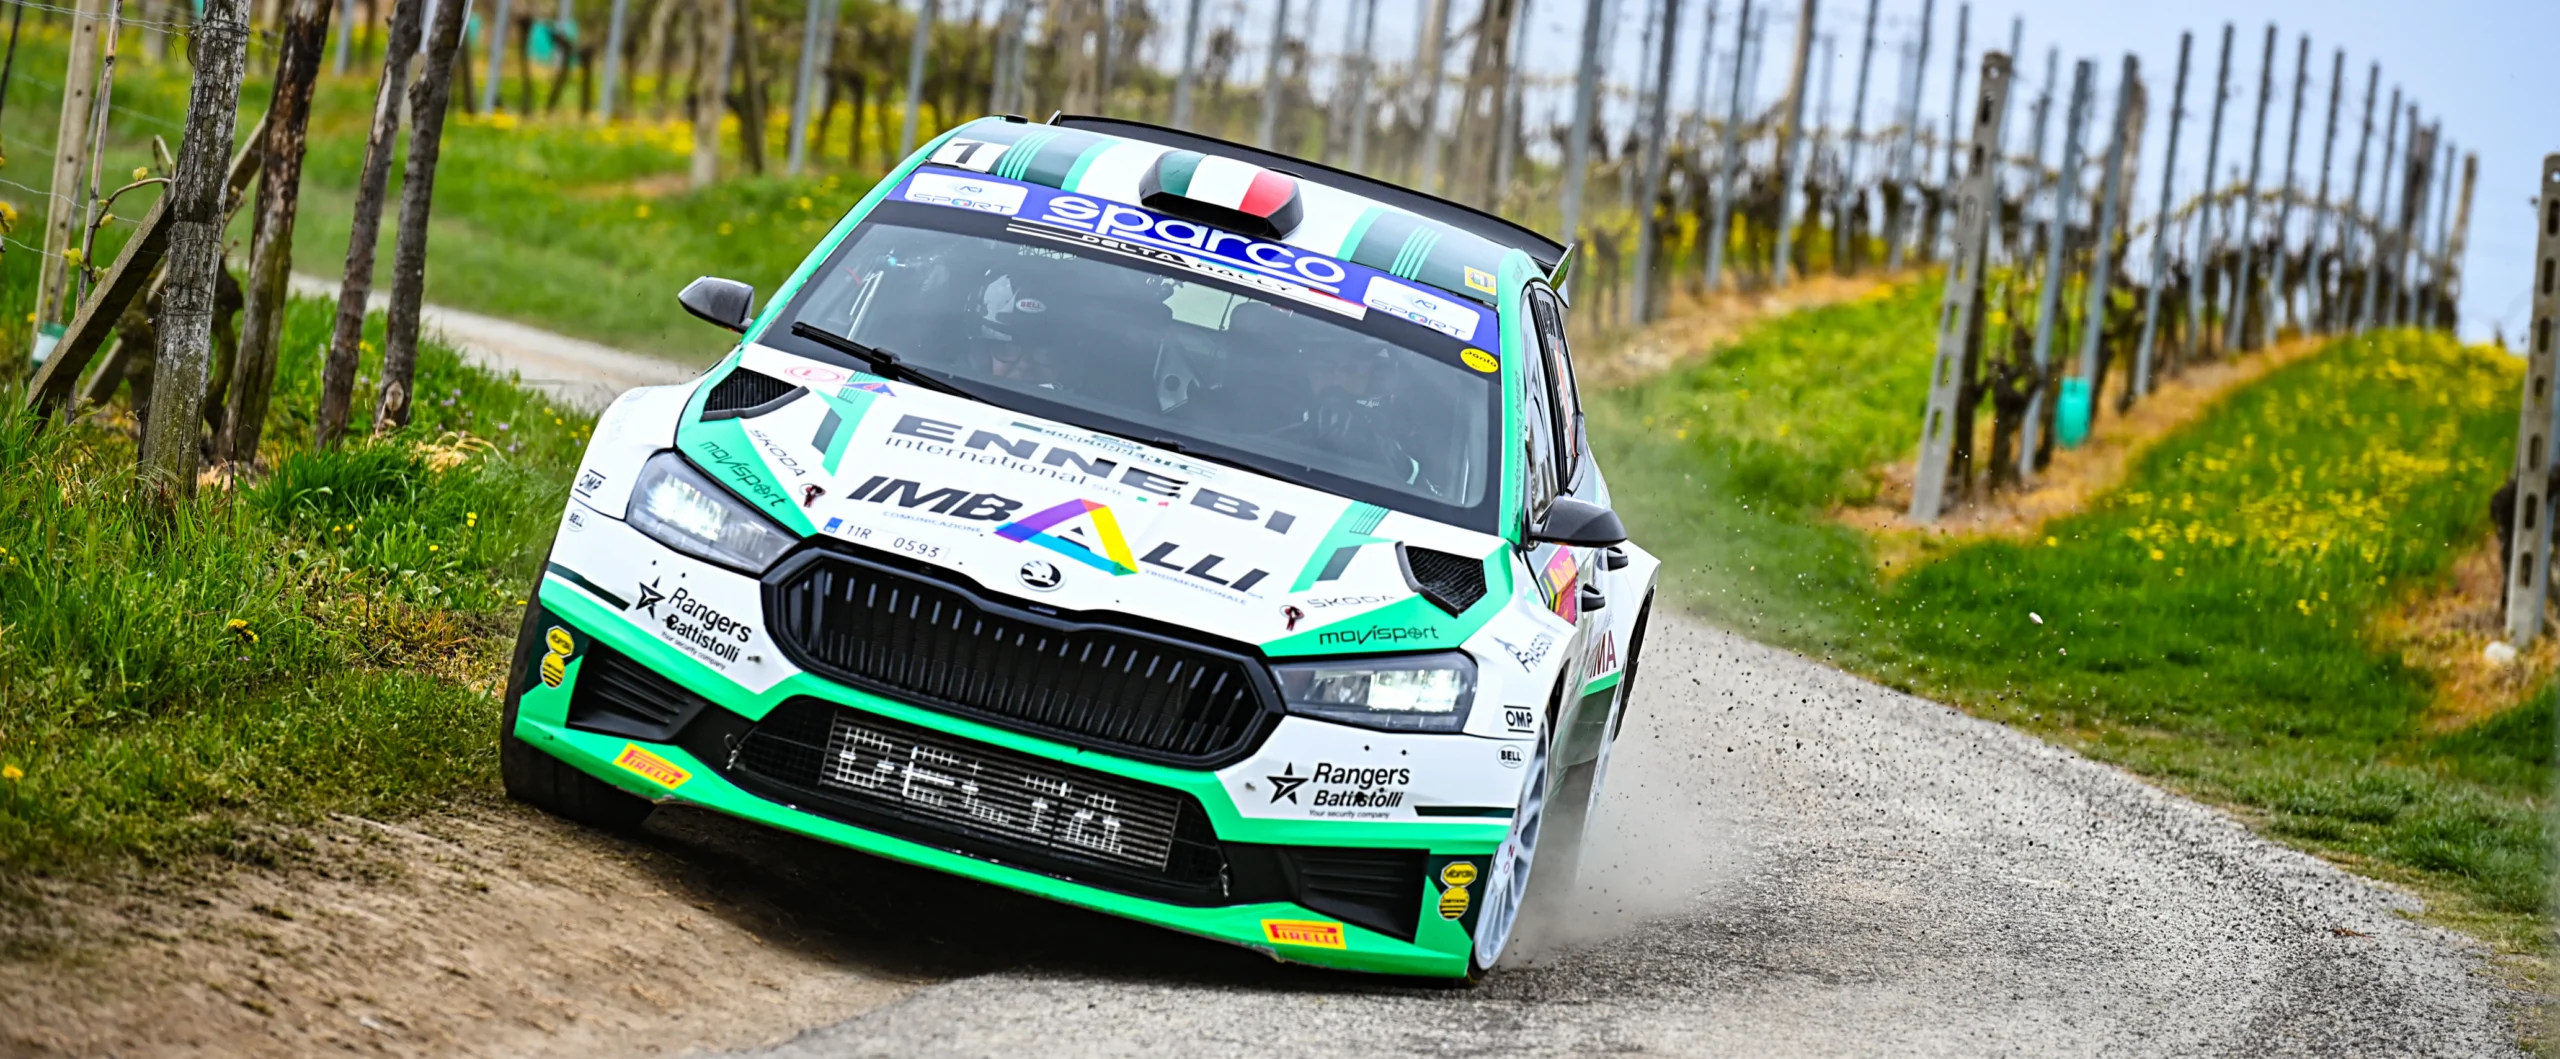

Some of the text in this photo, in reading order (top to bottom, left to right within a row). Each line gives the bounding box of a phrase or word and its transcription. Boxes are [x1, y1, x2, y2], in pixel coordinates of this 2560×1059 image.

[953, 142, 985, 165] 1
[913, 193, 1012, 213] SPORT
[1048, 195, 1346, 284] sparco
[1081, 234, 1293, 292] DELTA RALLY
[1371, 299, 1467, 336] SPORT
[885, 434, 1087, 486] international
[893, 413, 1296, 535] ENNEBI
[883, 510, 981, 533] COMUNICAZIONE
[893, 536, 940, 558] 0593
[668, 586, 752, 643] Rangers
[1505, 710, 1533, 728] OMP
[621, 749, 684, 787] PIRELLI
[1500, 749, 1522, 762] BELL
[1312, 762, 1410, 790] Rangers
[1309, 809, 1391, 820] Your security company
[1269, 923, 1339, 945] PIRELLI
